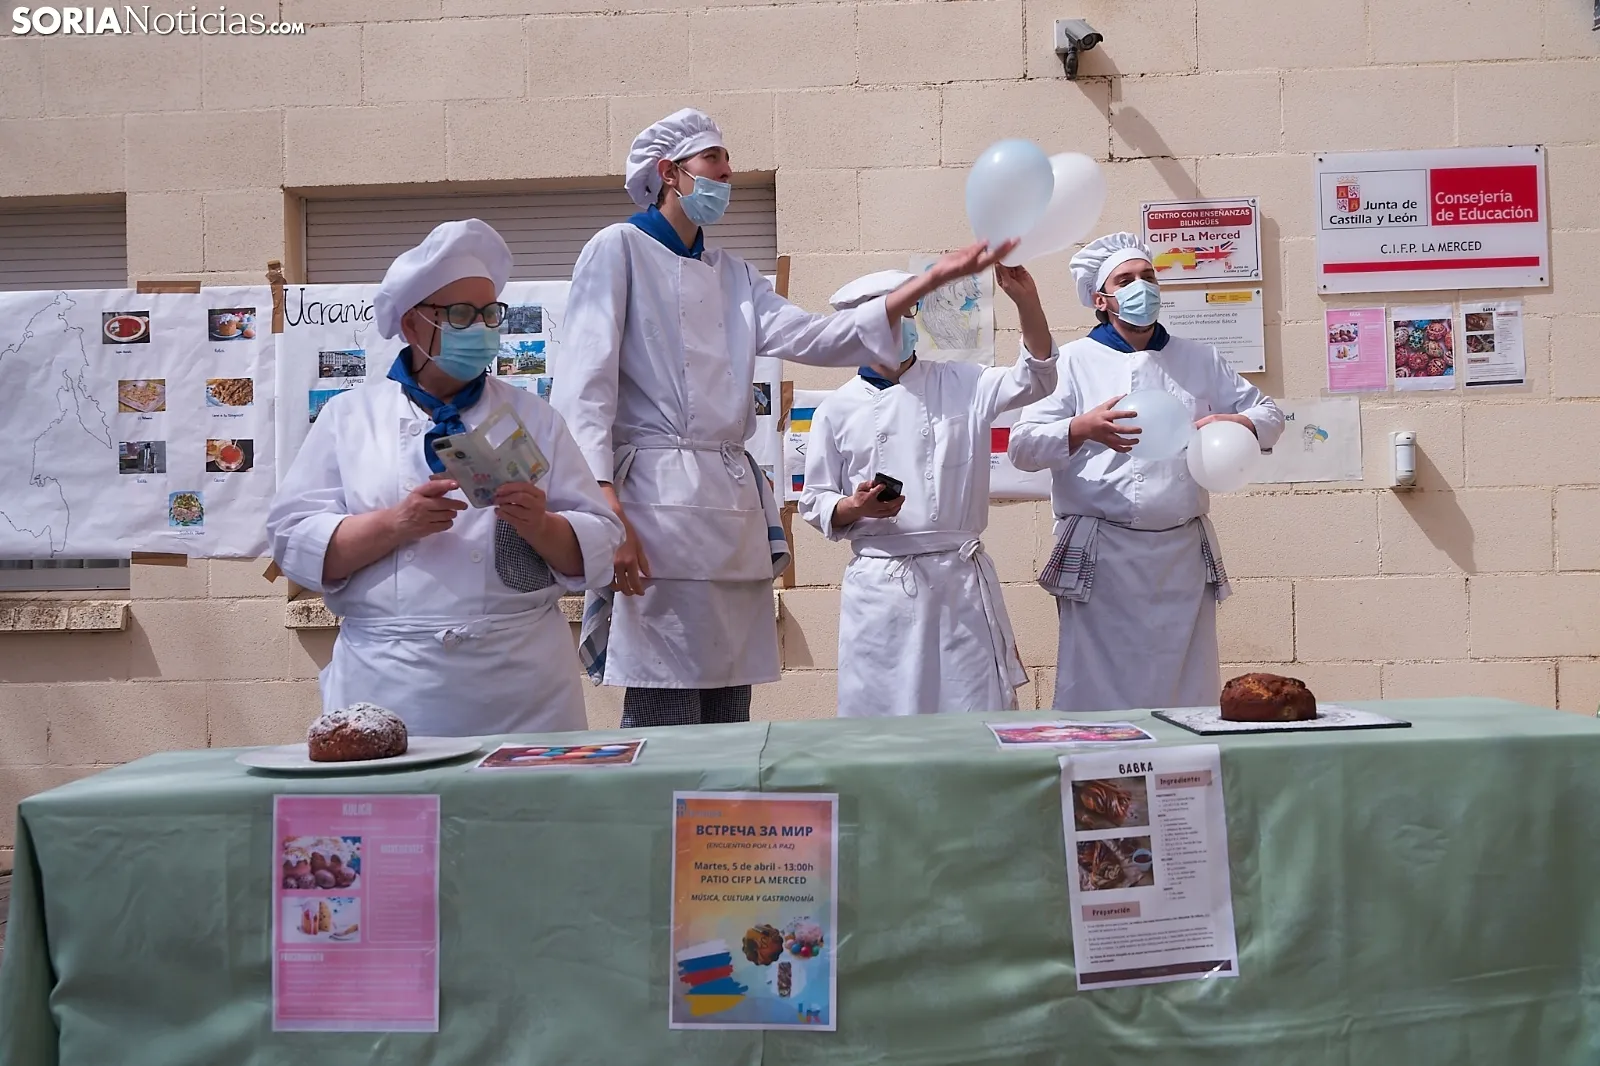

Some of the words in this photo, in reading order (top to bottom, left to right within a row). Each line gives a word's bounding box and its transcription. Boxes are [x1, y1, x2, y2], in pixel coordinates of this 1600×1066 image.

[1435, 190, 1512, 206] Consejería
[1364, 200, 1398, 210] Junta
[1402, 200, 1418, 209] de
[1200, 208, 1250, 218] ENSEÑANZAS
[1329, 213, 1372, 224] Castilla
[1376, 216, 1384, 226] y
[1388, 212, 1418, 223] León
[1436, 208, 1454, 221] de
[1459, 206, 1533, 220] Educación
[1180, 218, 1220, 226] BILINGÜES
[1150, 232, 1178, 242] CIFP
[1182, 232, 1195, 242] La
[1198, 230, 1240, 240] Merced
[1380, 243, 1417, 254] C.I.F.P.
[1421, 243, 1435, 253] LA
[1438, 241, 1482, 252] MERCED
[1118, 762, 1154, 774] BABKA
[1160, 776, 1201, 785] Ingredientes
[696, 825, 755, 837] ВСТРЕЧА
[760, 826, 778, 837] ЗА
[782, 826, 813, 837] МИР
[694, 862, 730, 872] Martes,
[732, 862, 738, 871] 5
[740, 862, 751, 871] de
[754, 862, 776, 871] abril
[784, 863, 814, 871] 13:00h
[1092, 906, 1130, 916] Preparación
